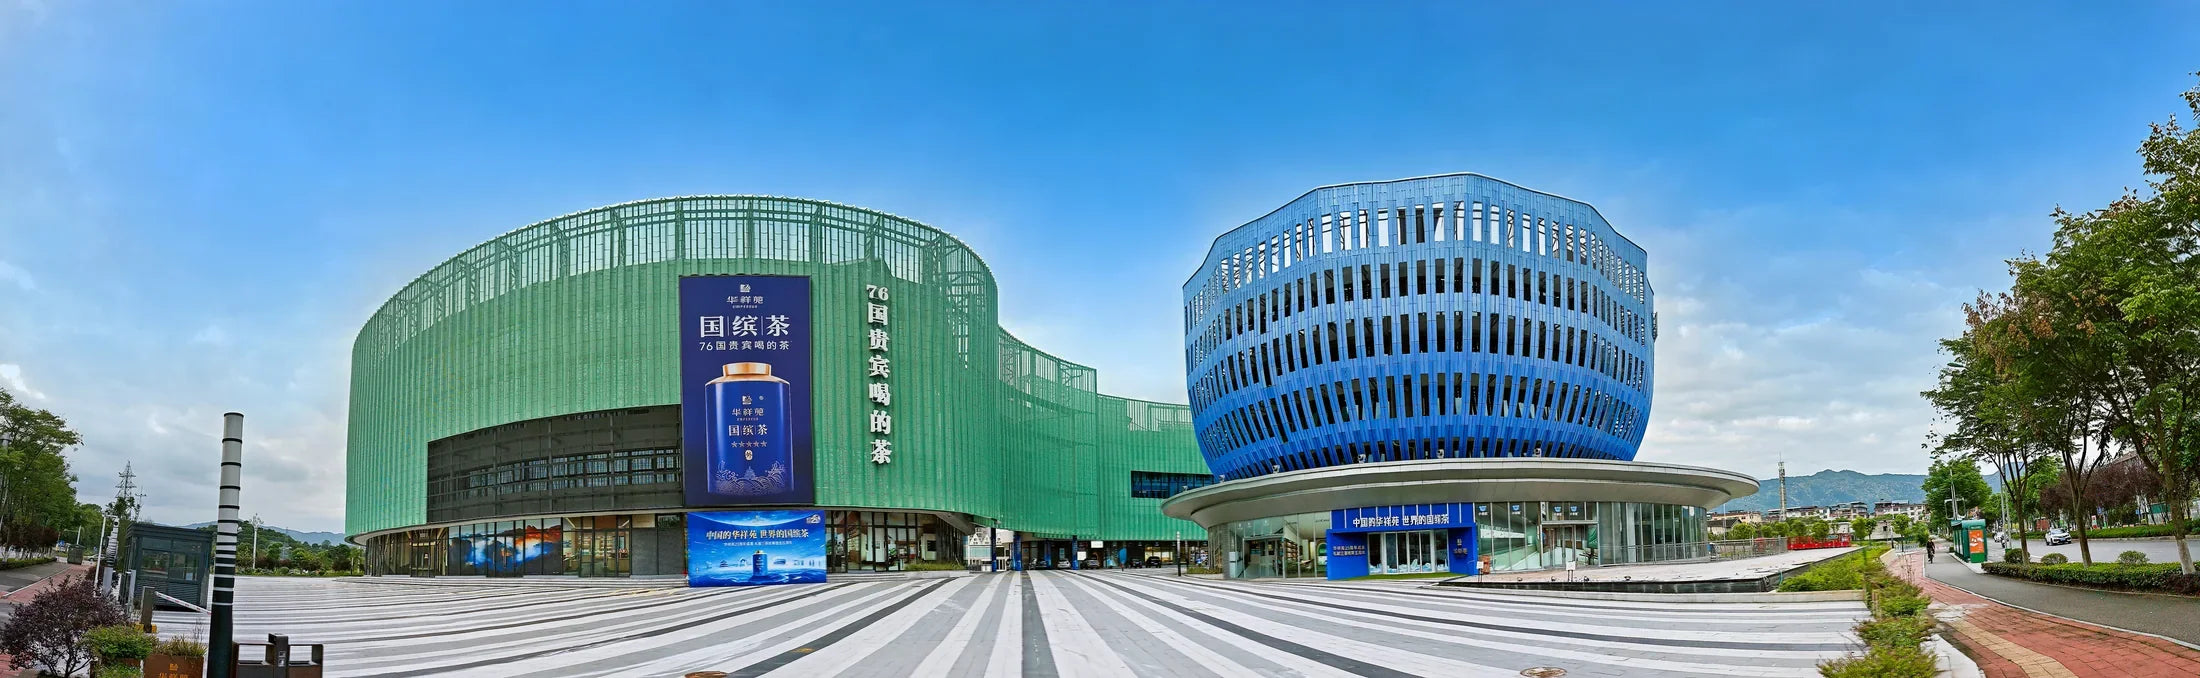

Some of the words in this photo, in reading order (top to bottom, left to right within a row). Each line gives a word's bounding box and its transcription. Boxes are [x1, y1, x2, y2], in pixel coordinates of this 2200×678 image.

[699, 314, 791, 338] 国缤茶
[699, 340, 790, 351] 76国贵宾喝的茶
[866, 284, 893, 465] 76国贵宾喝的茶
[728, 424, 768, 437] 国缤茶
[1352, 515, 1400, 528] 中国的华祥苑
[706, 530, 758, 540] 中国的华祥苑
